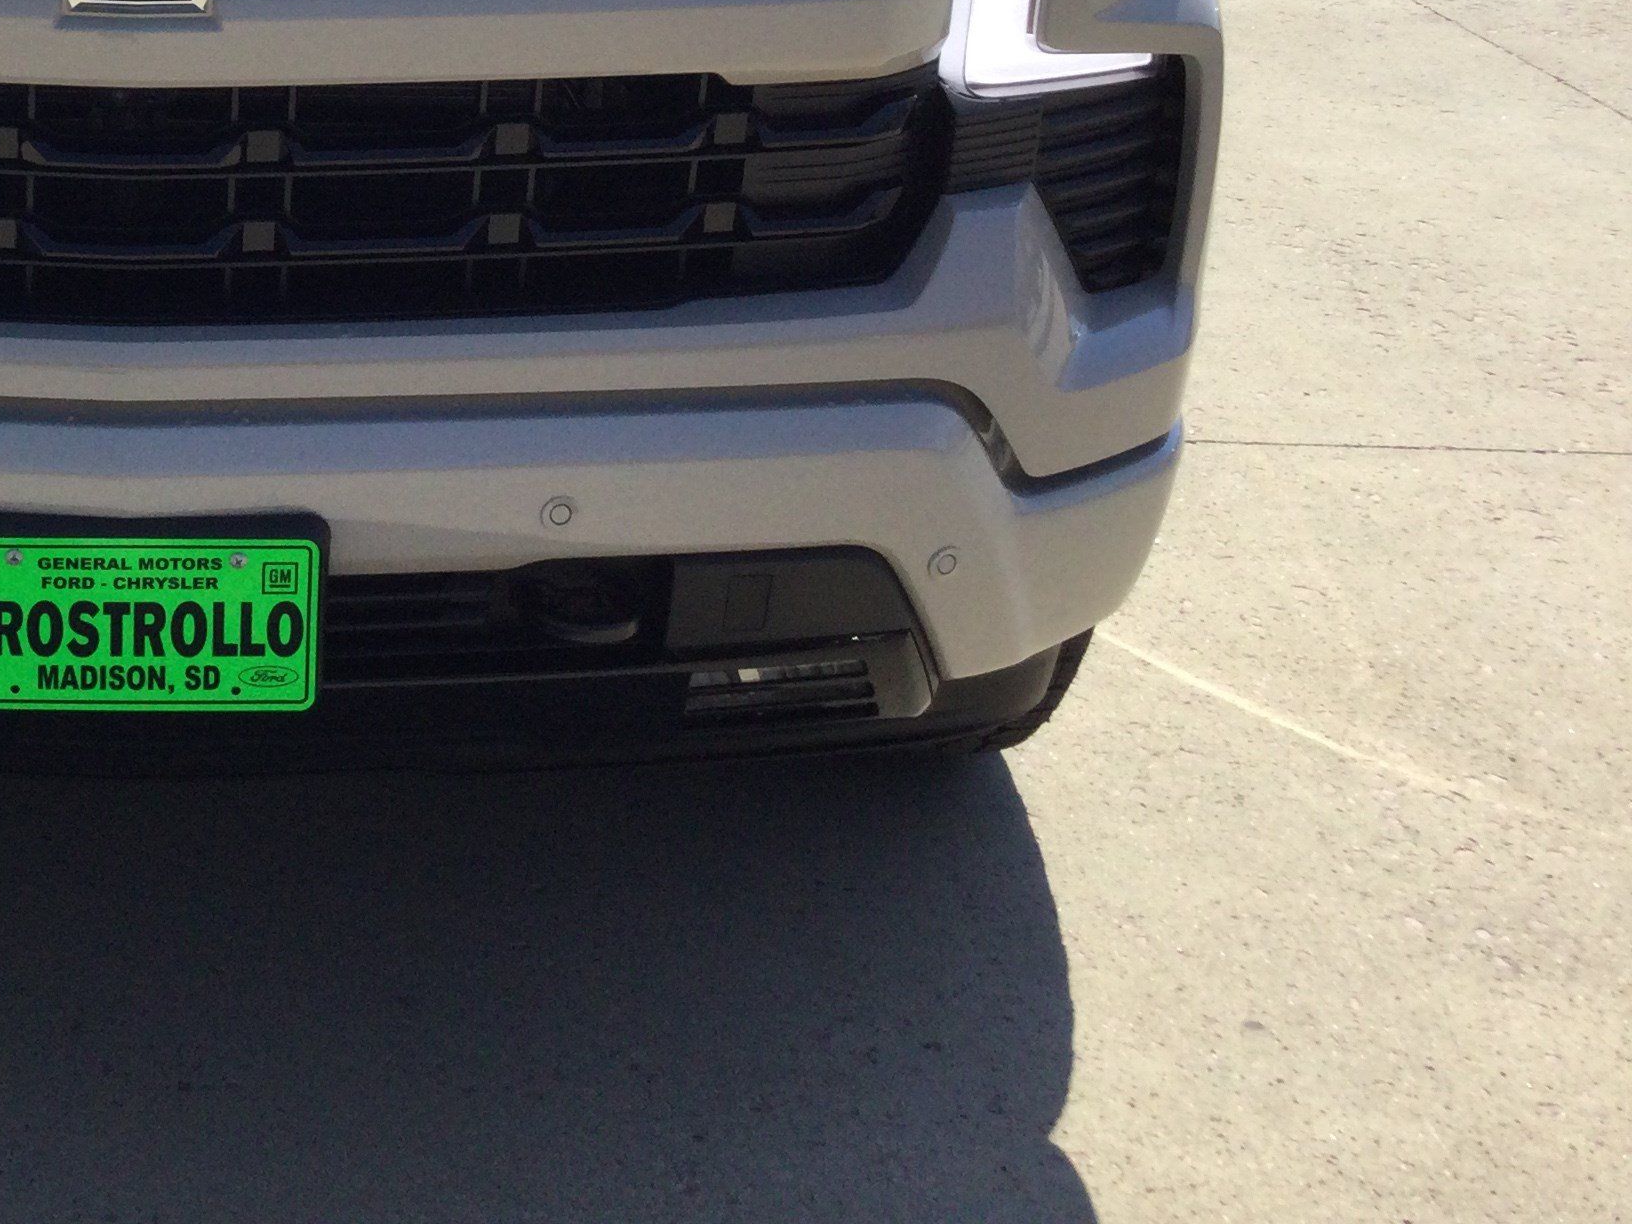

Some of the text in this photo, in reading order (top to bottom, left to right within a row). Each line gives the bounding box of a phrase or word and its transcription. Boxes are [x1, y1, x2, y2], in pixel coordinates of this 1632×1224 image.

[37, 557, 223, 571] GENERAL MOTORS
[41, 576, 95, 590] FORD
[113, 576, 219, 591] CHRYSLER
[269, 568, 292, 584] GM
[37, 664, 221, 693] MADISON, SD
[248, 668, 289, 684] Ford
